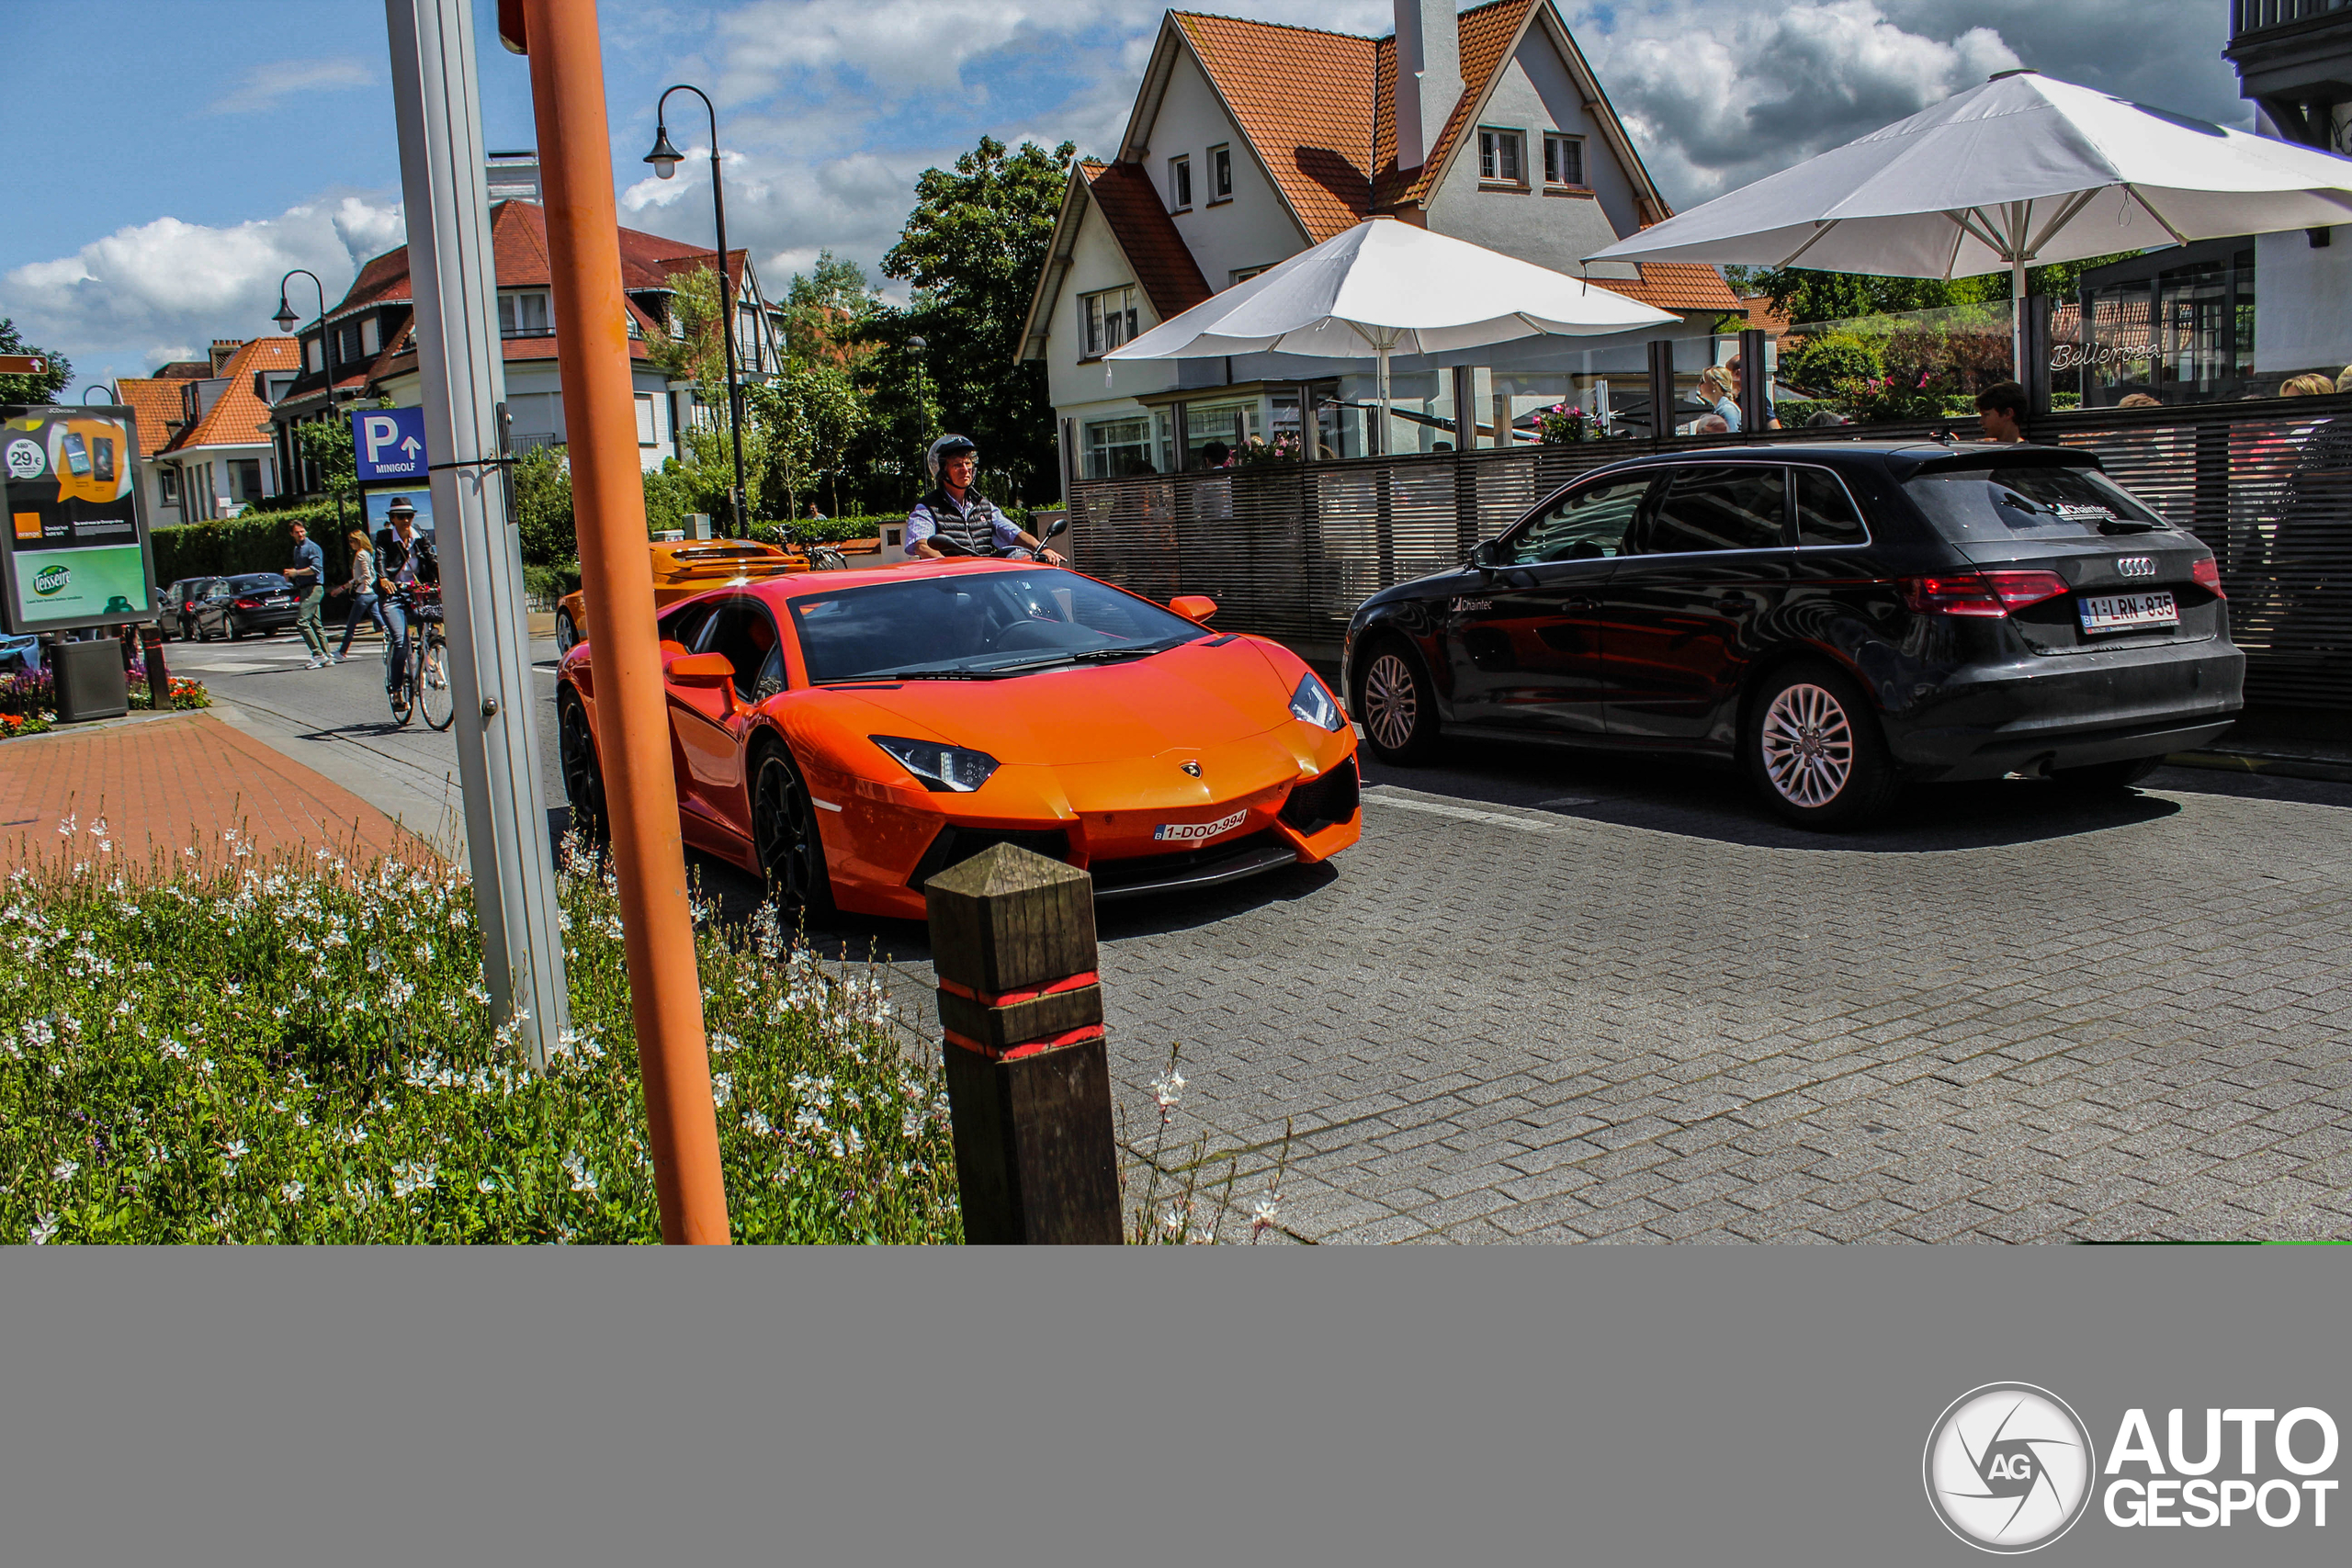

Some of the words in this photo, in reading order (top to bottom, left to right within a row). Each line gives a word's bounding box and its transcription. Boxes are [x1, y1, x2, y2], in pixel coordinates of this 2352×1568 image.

[364, 416, 399, 463] P
[11, 451, 32, 466] 29
[35, 457, 41, 466] €
[376, 462, 415, 474] MINIGOLF
[2064, 503, 2112, 514] Chaintec
[33, 568, 72, 592] Teisseire
[1462, 599, 1492, 611] Chaintec
[2083, 615, 2091, 625] B
[1167, 811, 1245, 839] 1-DOO-994
